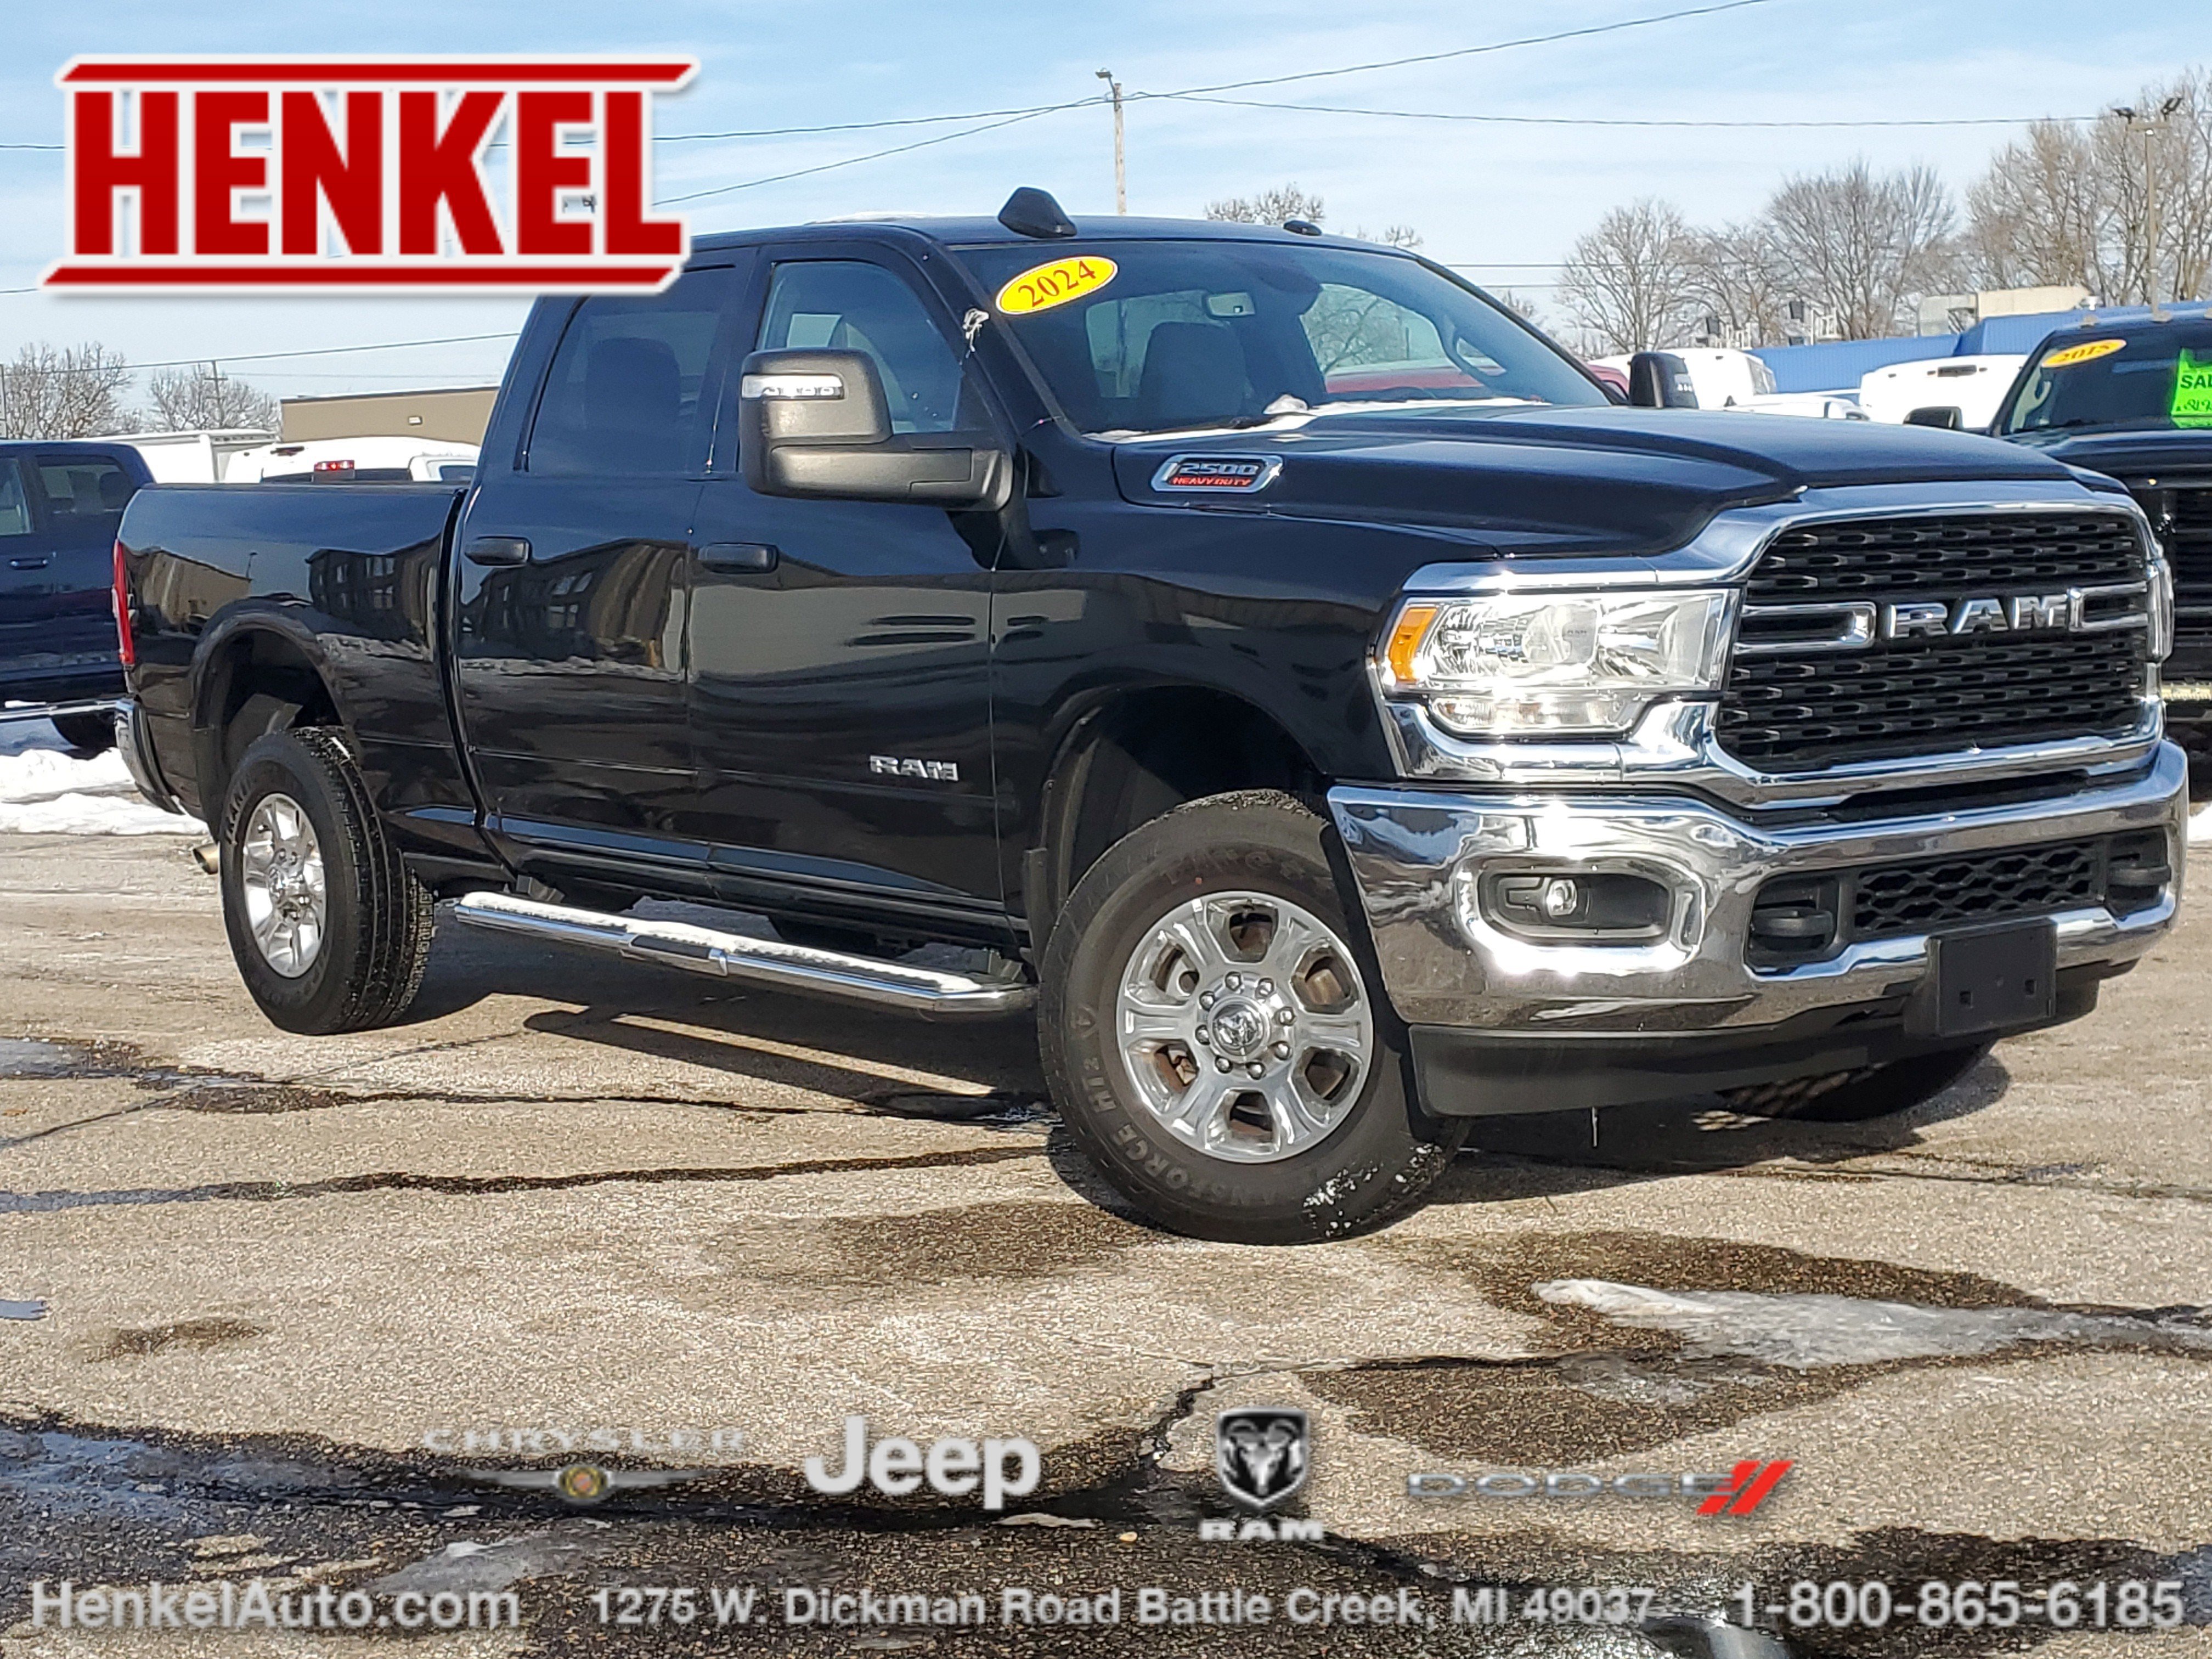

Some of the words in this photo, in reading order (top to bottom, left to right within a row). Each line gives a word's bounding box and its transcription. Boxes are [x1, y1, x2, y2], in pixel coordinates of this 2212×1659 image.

[1018, 260, 1096, 307] 2024
[1172, 477, 1211, 486] HEAVY
[1178, 462, 1259, 476] 2500
[1889, 595, 2068, 638] RAM
[870, 754, 959, 782] RAM
